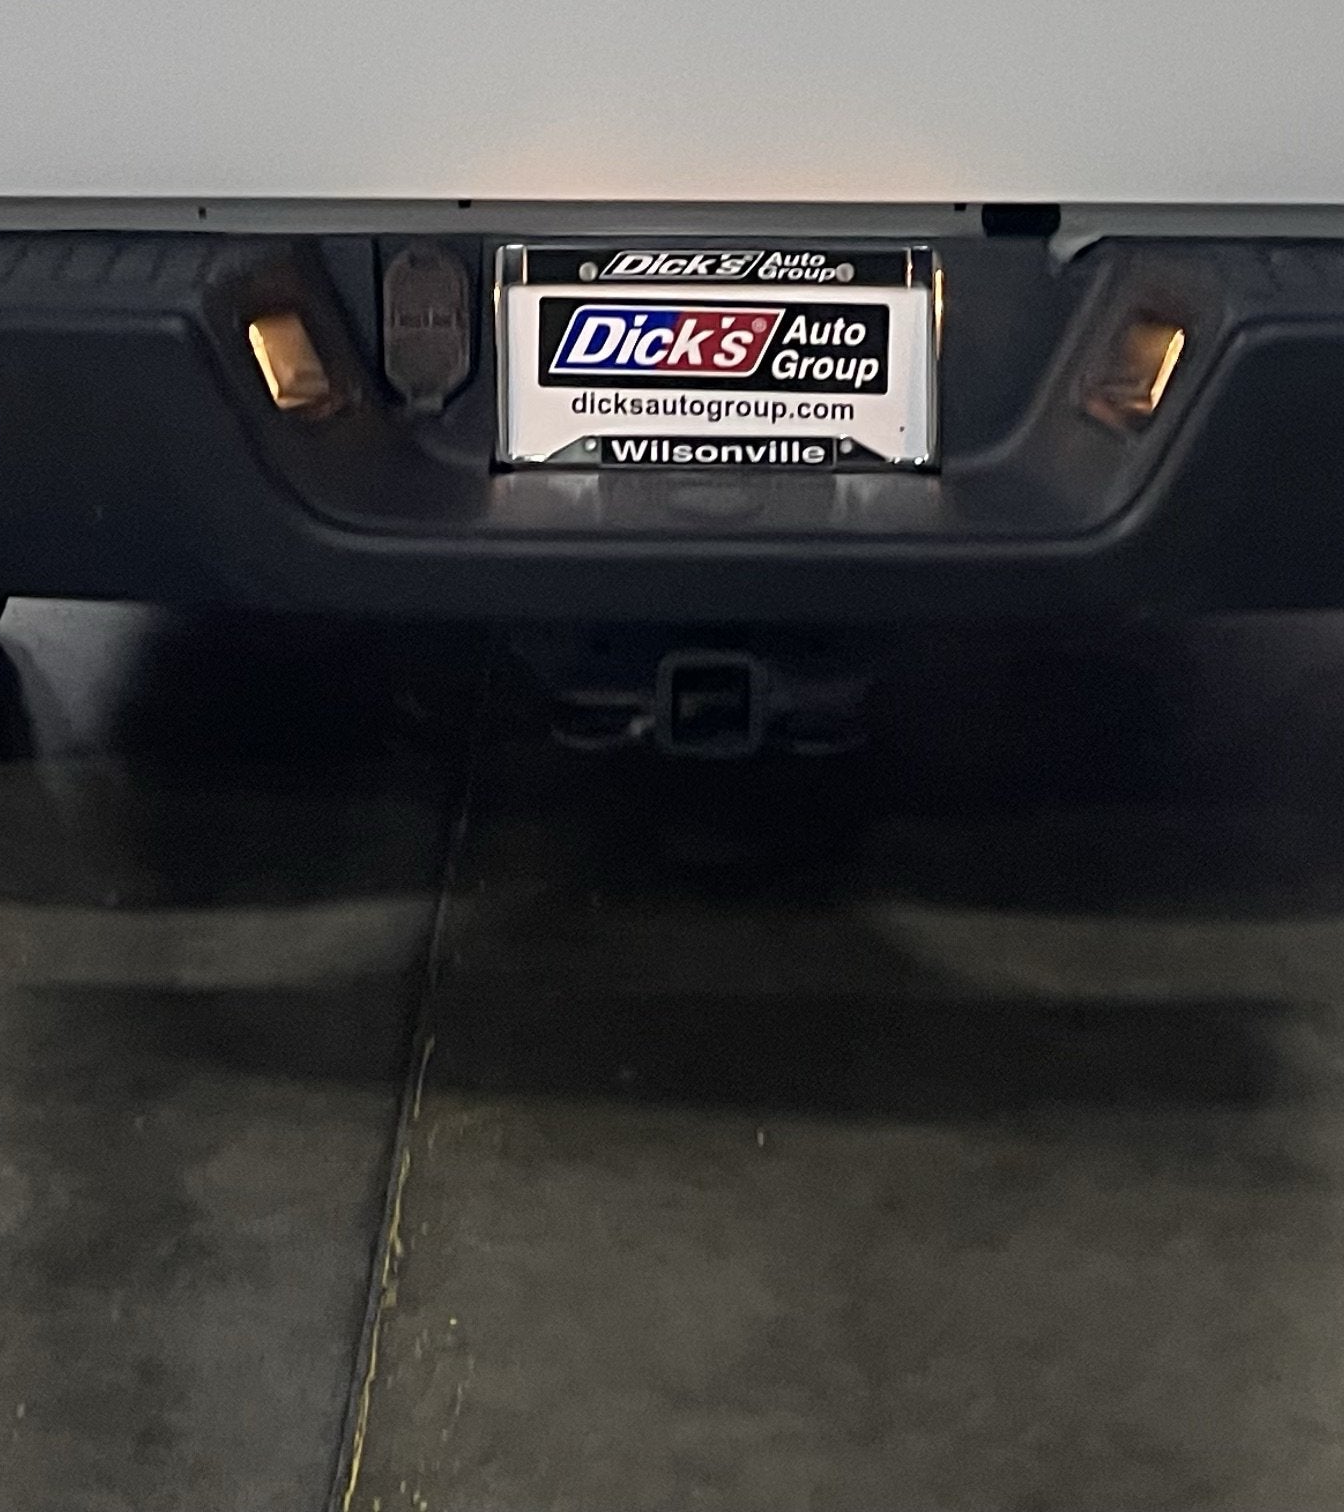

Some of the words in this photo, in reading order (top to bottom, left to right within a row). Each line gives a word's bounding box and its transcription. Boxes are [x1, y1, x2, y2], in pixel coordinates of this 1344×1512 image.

[611, 252, 753, 276] Dick's
[764, 250, 826, 268] Auto
[757, 266, 837, 284] Group
[566, 313, 754, 368] Dick's
[782, 315, 866, 347] Auto
[771, 350, 880, 388] Group
[571, 392, 855, 423] dicksautogroup.com
[611, 439, 826, 465] Wilsonville
